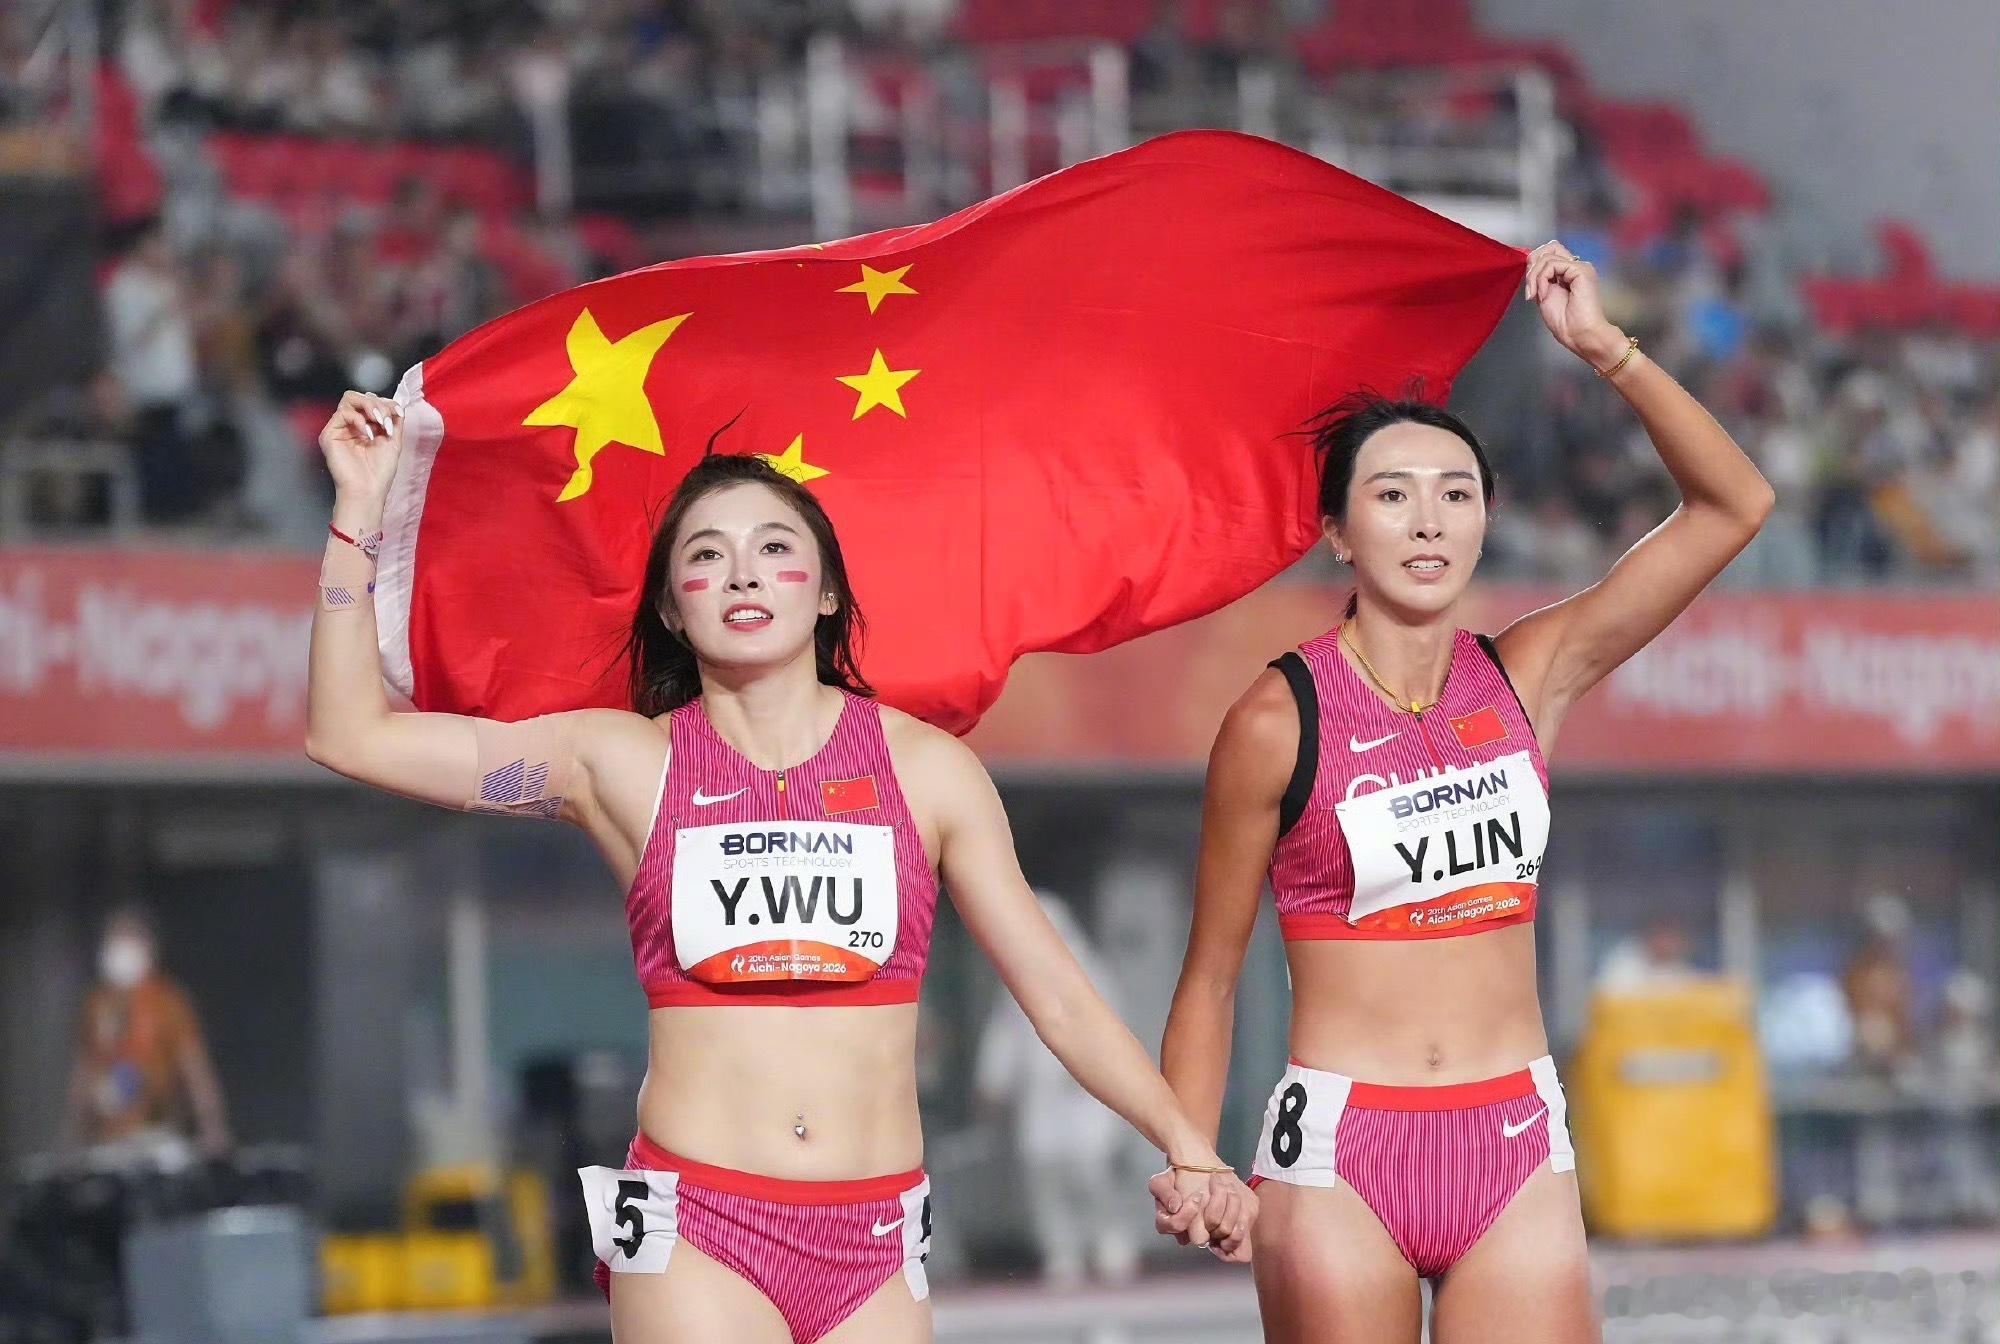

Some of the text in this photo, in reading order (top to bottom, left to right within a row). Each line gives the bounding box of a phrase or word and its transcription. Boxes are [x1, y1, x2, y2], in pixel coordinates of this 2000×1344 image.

[1387, 769, 1509, 819] BORNAN
[1397, 794, 1511, 832] SPORTS TECHNOLOGY
[720, 832, 853, 855] BORNAN
[1394, 811, 1524, 883] Y.LIN
[724, 856, 852, 869] SPORTS TECHNOLOGY
[710, 876, 863, 925] Y.WU
[1427, 897, 1521, 924] Aichi-Nagoya 2026
[1447, 903, 1467, 913] Asian
[1467, 896, 1494, 906] Games
[848, 930, 884, 948] 270
[748, 955, 768, 963] 20th
[794, 954, 821, 962] Games
[748, 962, 847, 974] Aichi-Nagoya 2026
[1271, 1082, 1308, 1168] 8
[612, 1180, 649, 1259] 5
